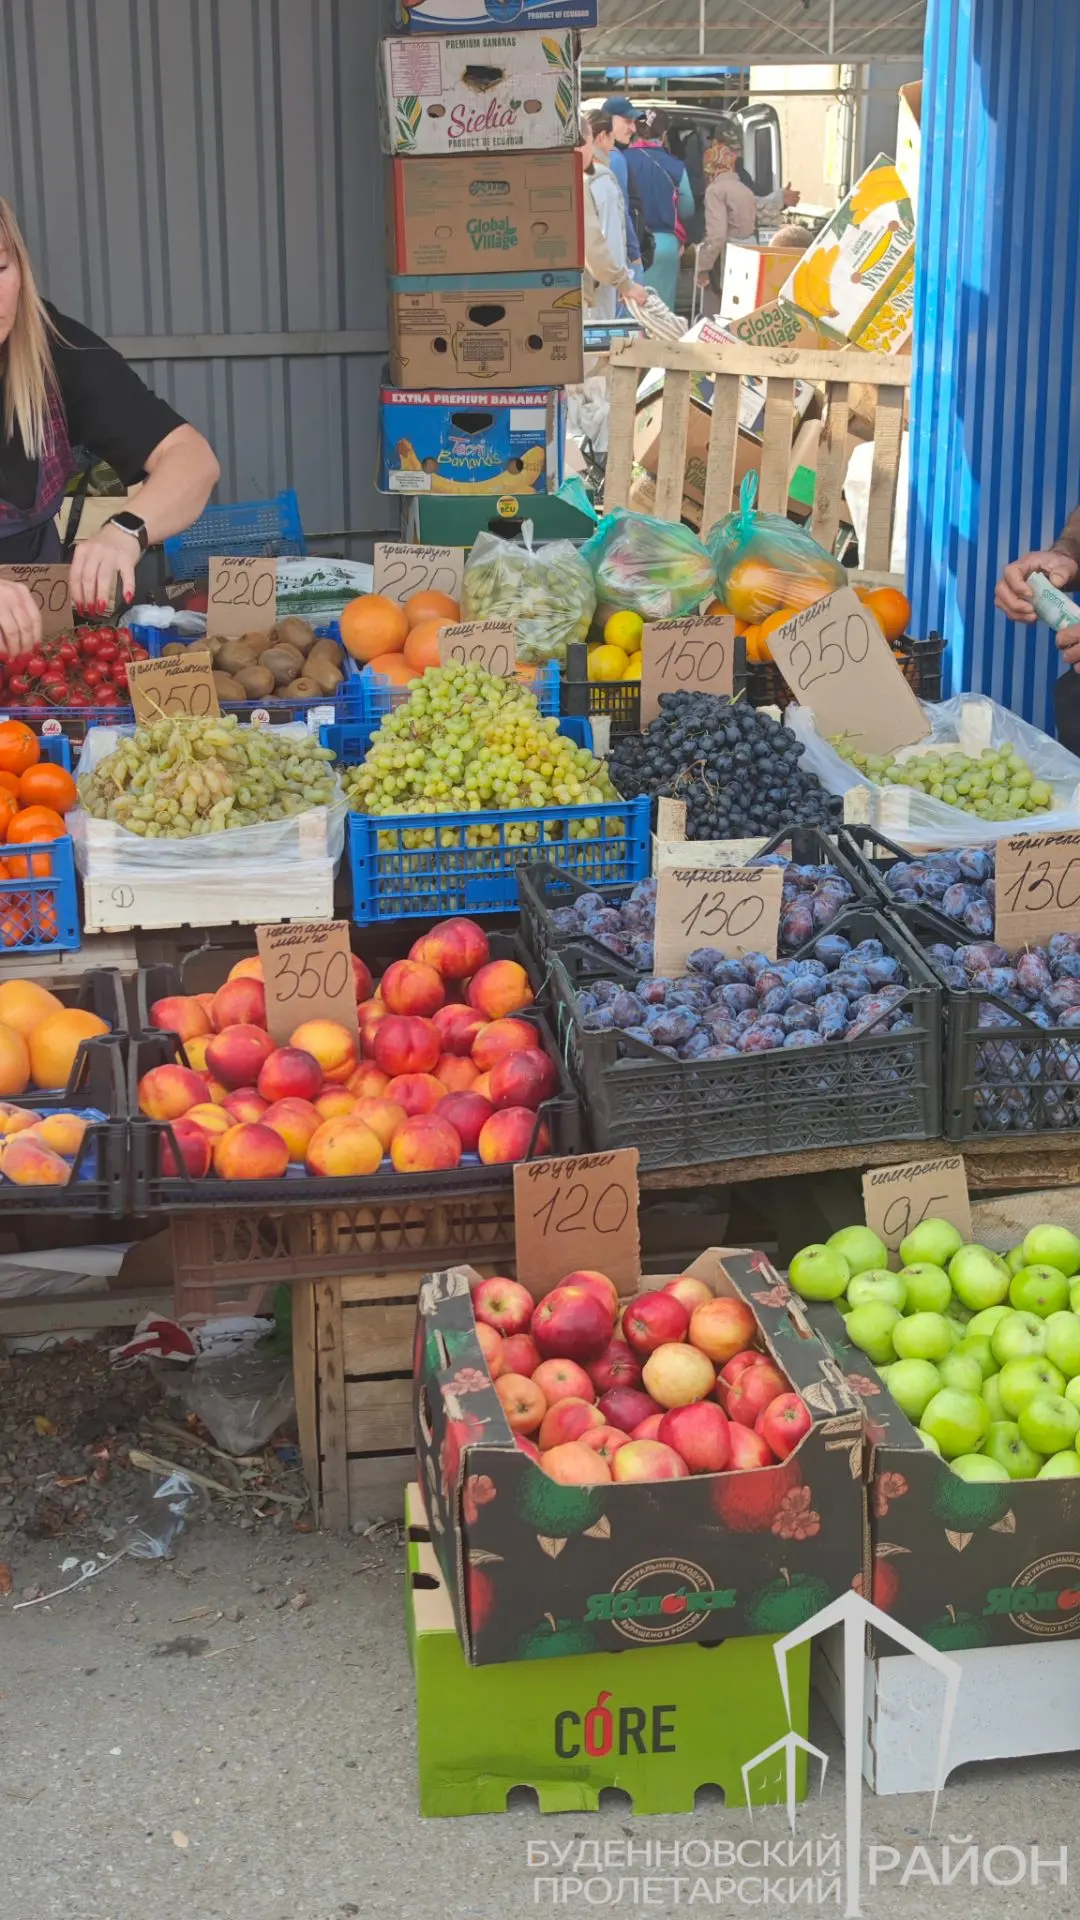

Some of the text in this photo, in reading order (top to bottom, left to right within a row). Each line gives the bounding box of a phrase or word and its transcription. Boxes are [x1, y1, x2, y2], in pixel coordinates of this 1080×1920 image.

[528, 12, 554, 20] PRODUCT
[563, 9, 590, 18] ECUADOR
[445, 36, 517, 49] PREMIUM BANANAS
[447, 97, 516, 138] Sielia
[448, 137, 480, 148] PRODUCT
[492, 135, 524, 146] ECUADOR
[466, 216, 510, 236] Global
[470, 231, 518, 251] Village
[860, 244, 902, 292] BANANAS
[391, 393, 548, 406] EXTRA PREMIUM BANANAS
[222, 558, 255, 567] киви
[13, 578, 69, 612] 50
[211, 570, 274, 607] 220
[377, 561, 457, 603] 220
[655, 641, 725, 682] 150
[789, 614, 870, 691] 250
[1004, 857, 1080, 912] 130
[681, 891, 765, 937] 130
[275, 950, 349, 1002] 350
[533, 1183, 629, 1236] 120
[619, 1560, 707, 1592] НАТУРАЛЬНЫЙ ПРОДУКТ
[982, 1583, 1080, 1616] Ябло
[620, 1618, 663, 1639] ВЫРАЩЕНО
[671, 1613, 700, 1636] РОССИИ
